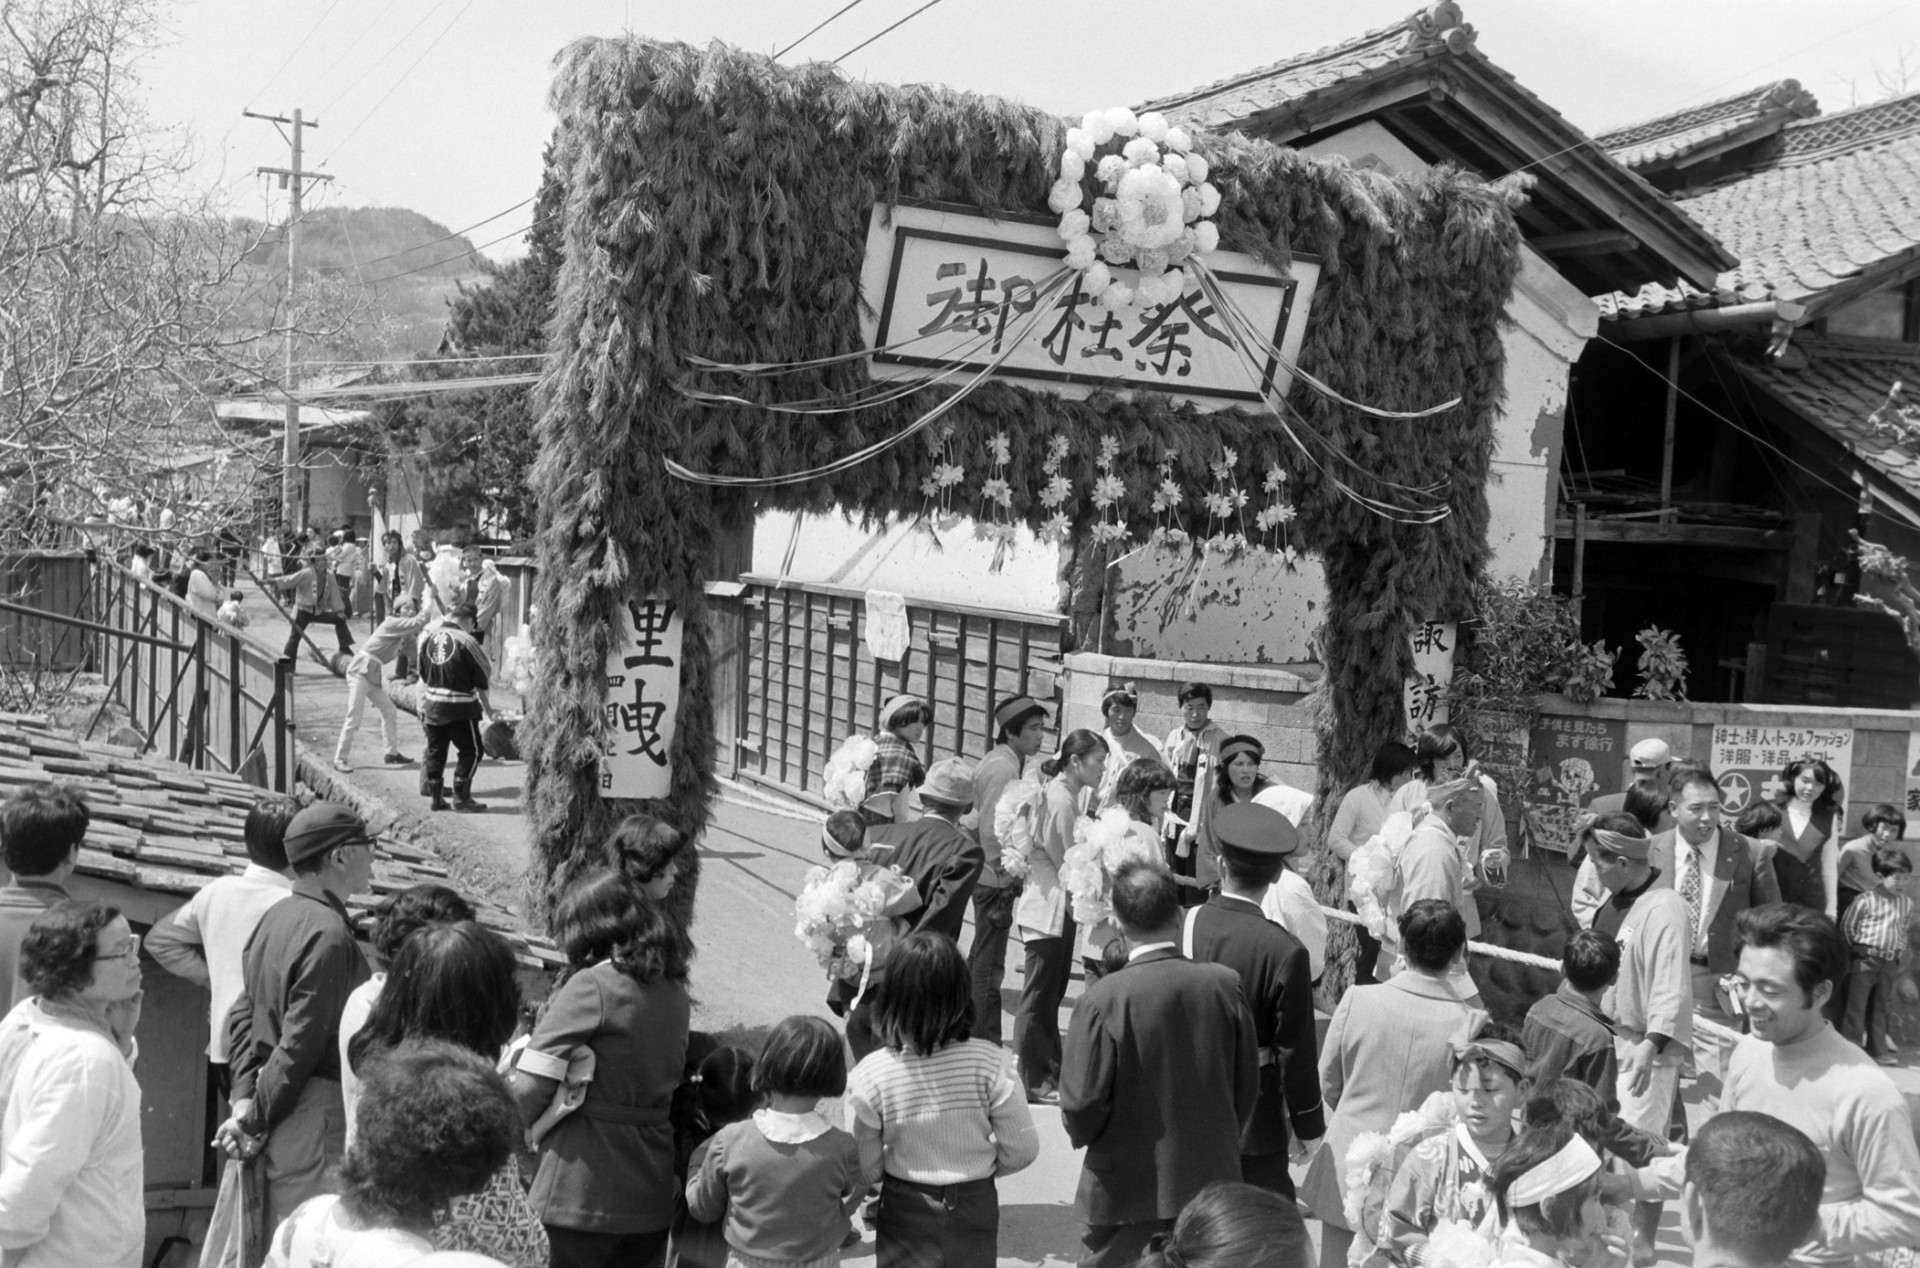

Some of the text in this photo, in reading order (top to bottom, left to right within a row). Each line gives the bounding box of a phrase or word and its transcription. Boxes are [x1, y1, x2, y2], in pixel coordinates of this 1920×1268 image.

[623, 600, 676, 767] 里曳
[1409, 620, 1449, 722] 諏訪
[1555, 733, 1614, 752] まず徐行
